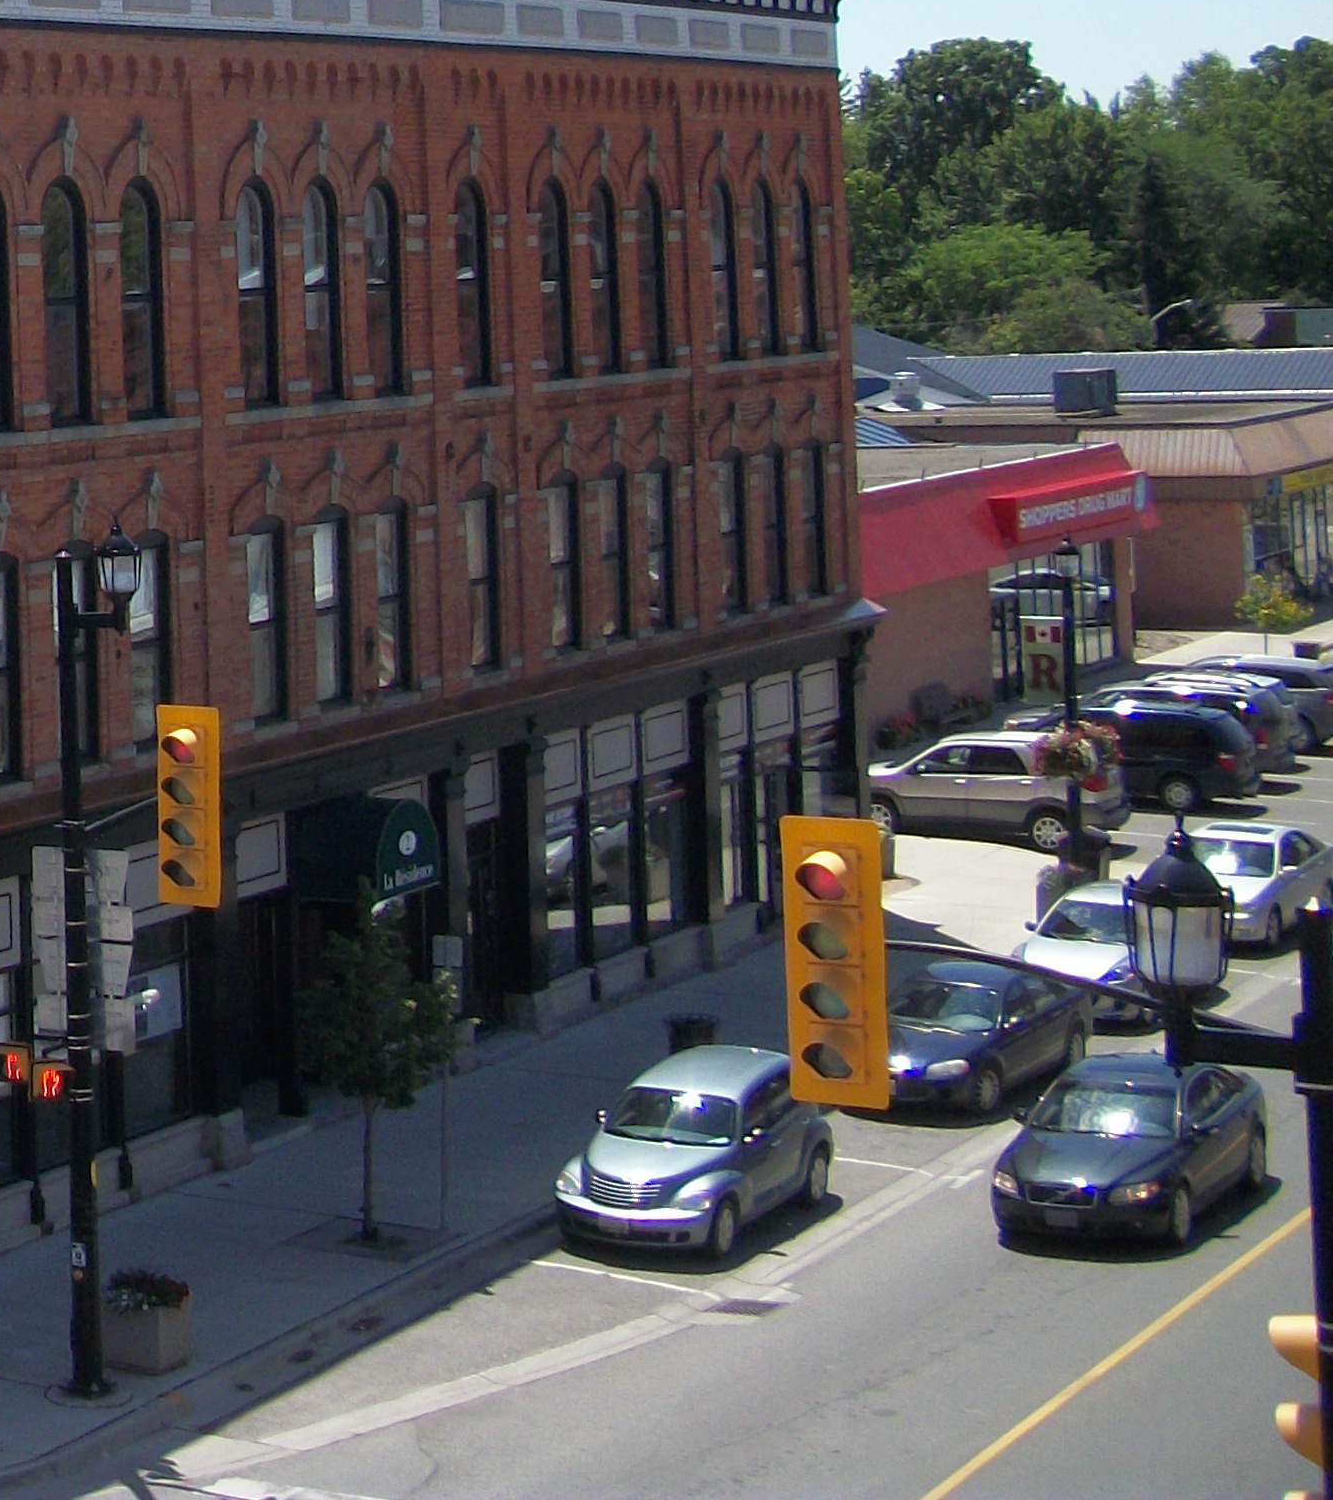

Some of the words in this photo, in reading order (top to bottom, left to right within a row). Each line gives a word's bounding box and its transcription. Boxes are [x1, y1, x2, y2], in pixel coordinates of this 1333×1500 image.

[1019, 498, 1076, 528] SHOPPERS
[1078, 492, 1106, 516] DRUG
[1106, 487, 1132, 509] MART
[1028, 653, 1060, 692] R
